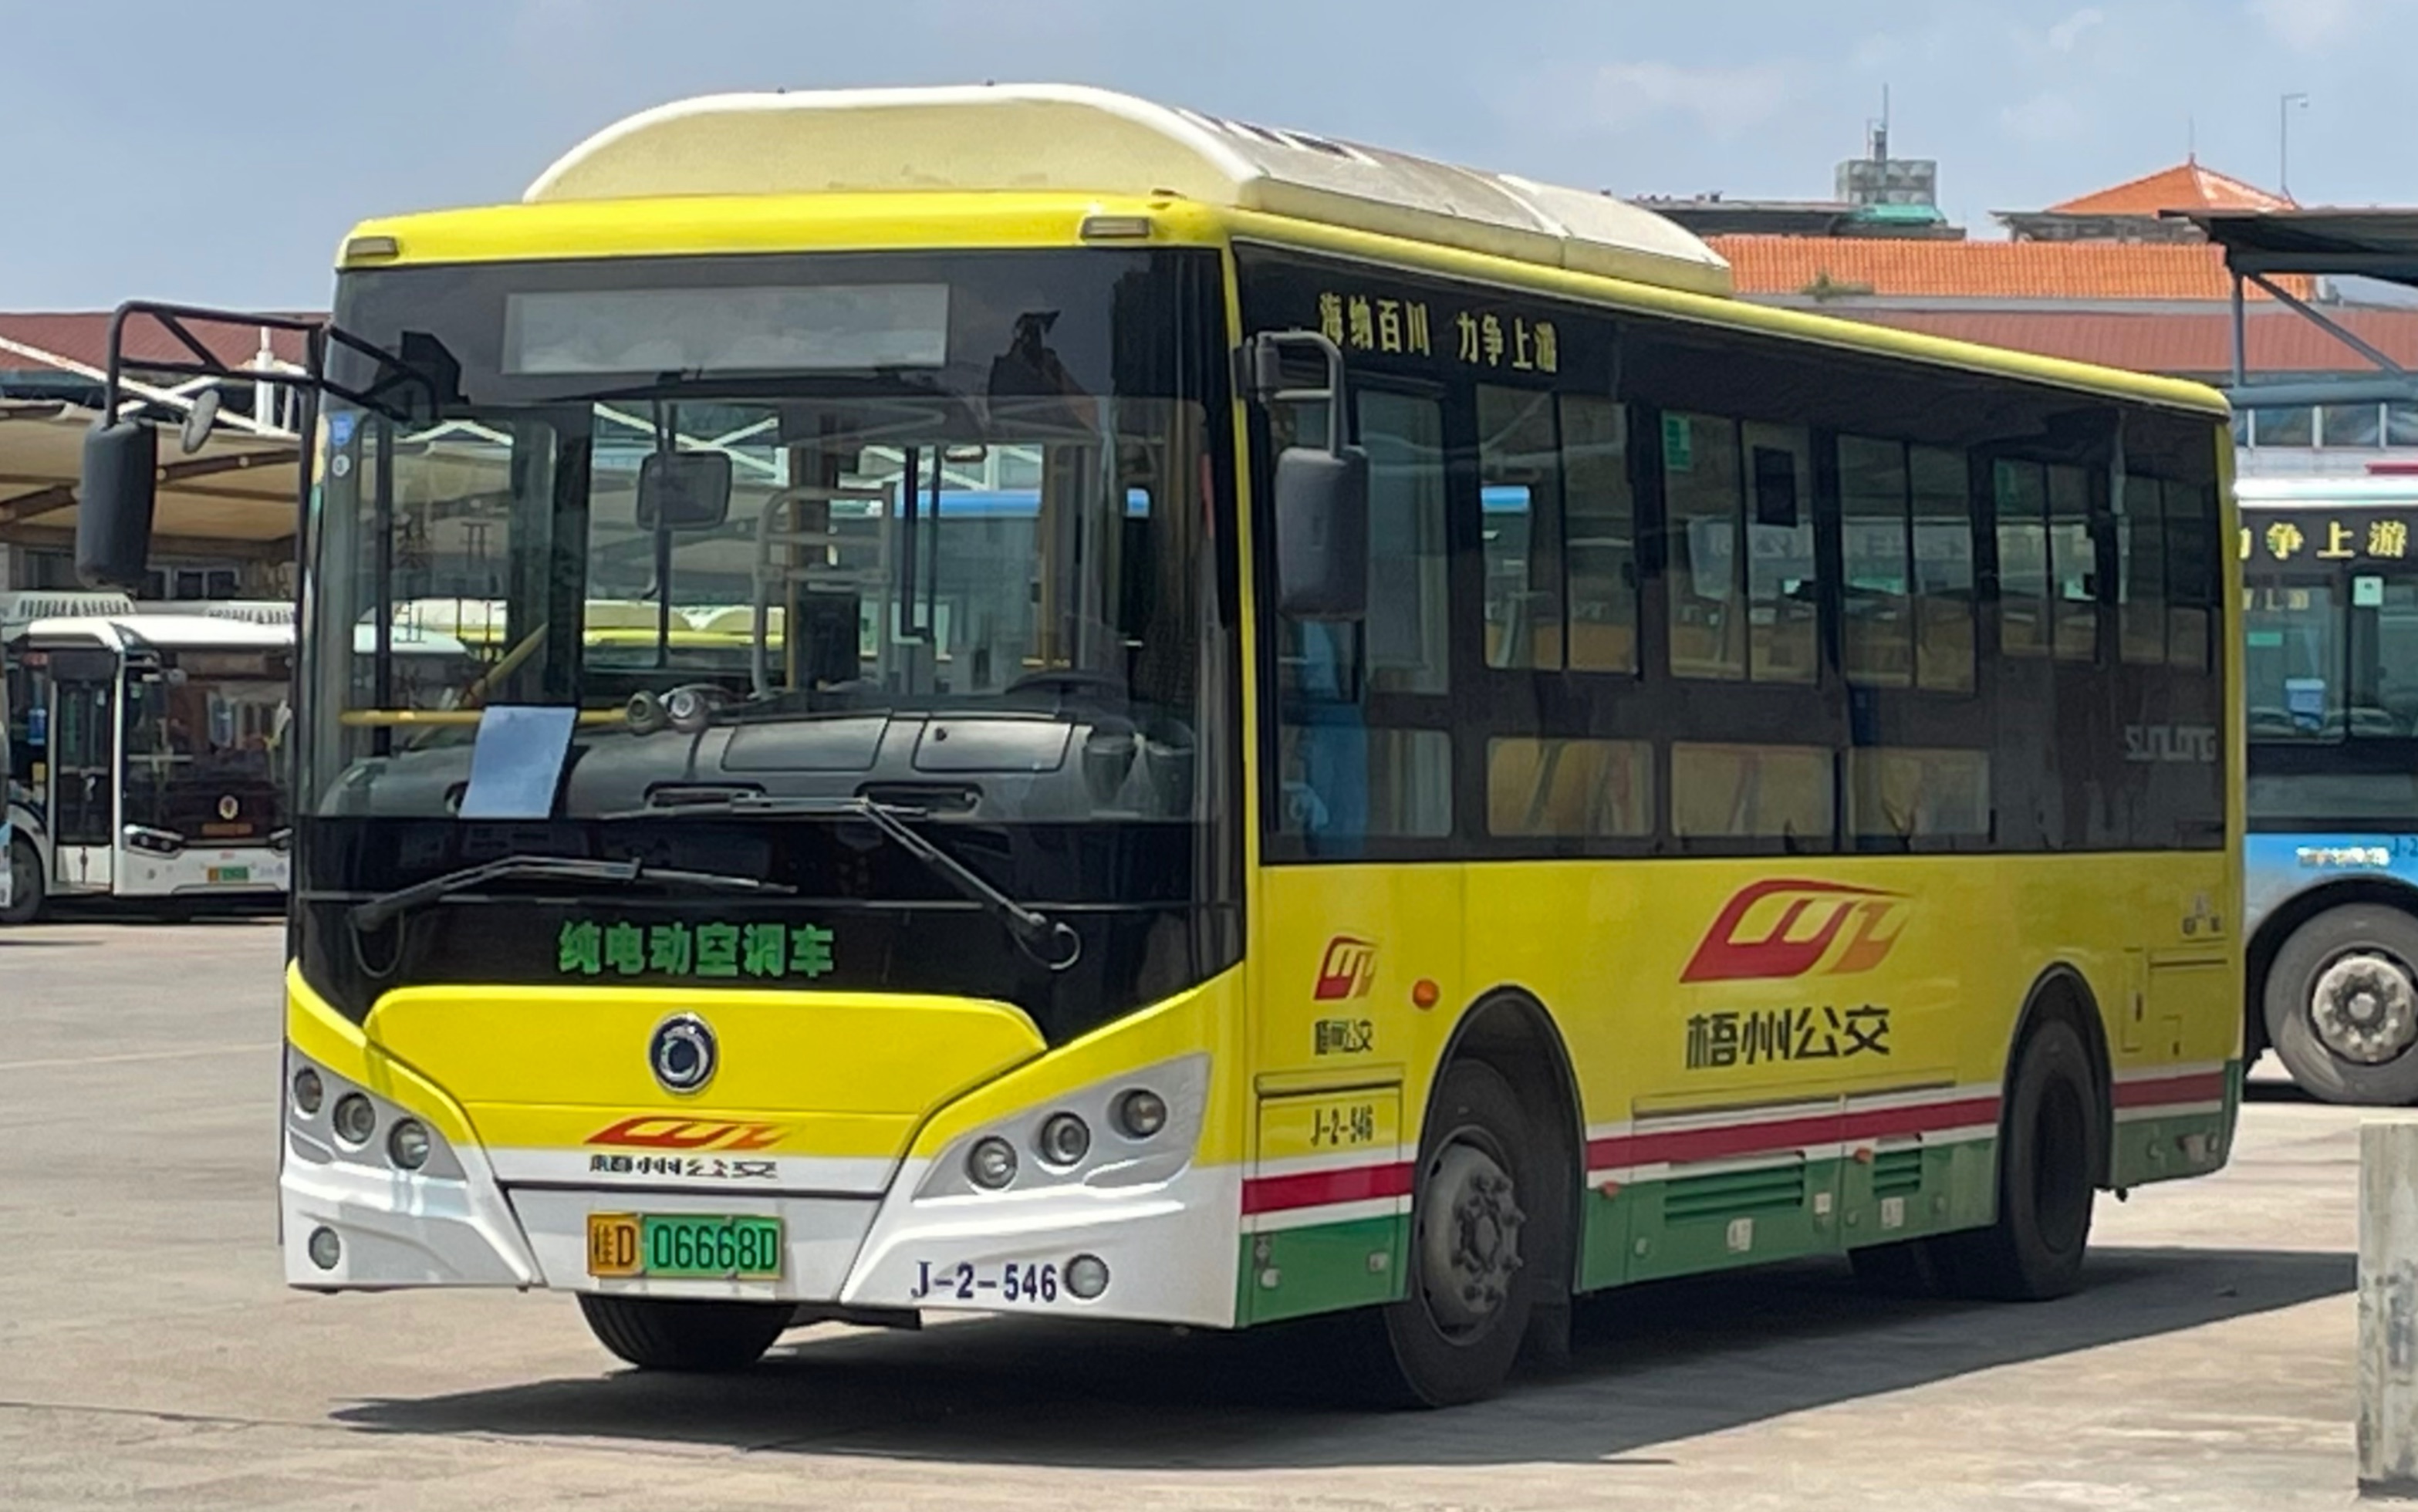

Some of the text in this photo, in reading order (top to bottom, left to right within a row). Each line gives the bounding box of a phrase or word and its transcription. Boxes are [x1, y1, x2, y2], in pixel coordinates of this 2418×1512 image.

[1319, 292, 1557, 373] 海纳百川 力争上游
[559, 920, 834, 977] 纯电动空调车
[1687, 1004, 1890, 1070] 梧州公交
[1311, 1105, 1373, 1146] J-2-546
[589, 1154, 778, 1179] 梧州公交
[910, 1261, 1057, 1302] J-2-546
